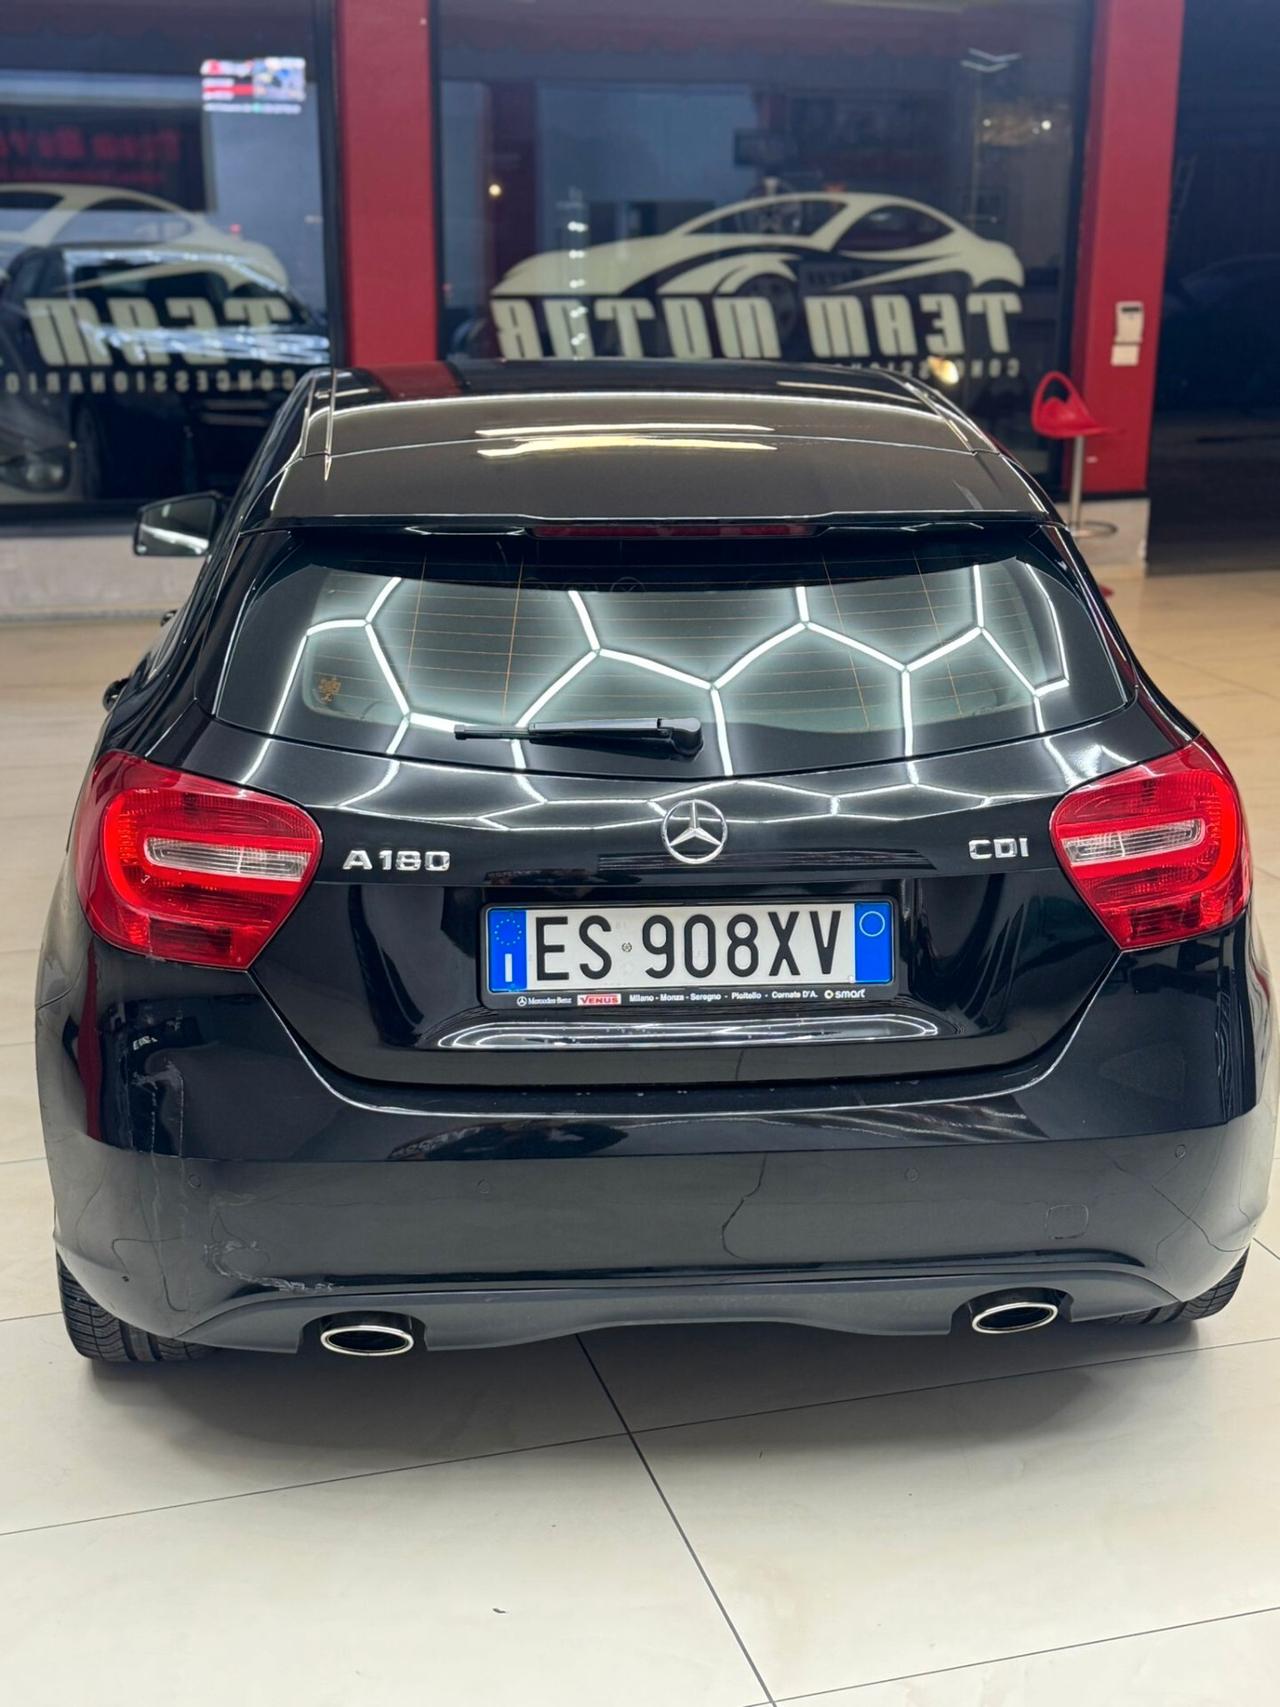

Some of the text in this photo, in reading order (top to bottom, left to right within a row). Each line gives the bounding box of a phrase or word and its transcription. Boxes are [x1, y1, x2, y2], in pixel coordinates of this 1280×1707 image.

[968, 837, 1029, 860] CDI
[342, 849, 451, 872] A180
[535, 910, 842, 981] ES 908XV
[504, 953, 513, 983] I
[629, 993, 654, 1002] Milano
[660, 993, 684, 1002] Monza
[834, 988, 866, 999] smart
